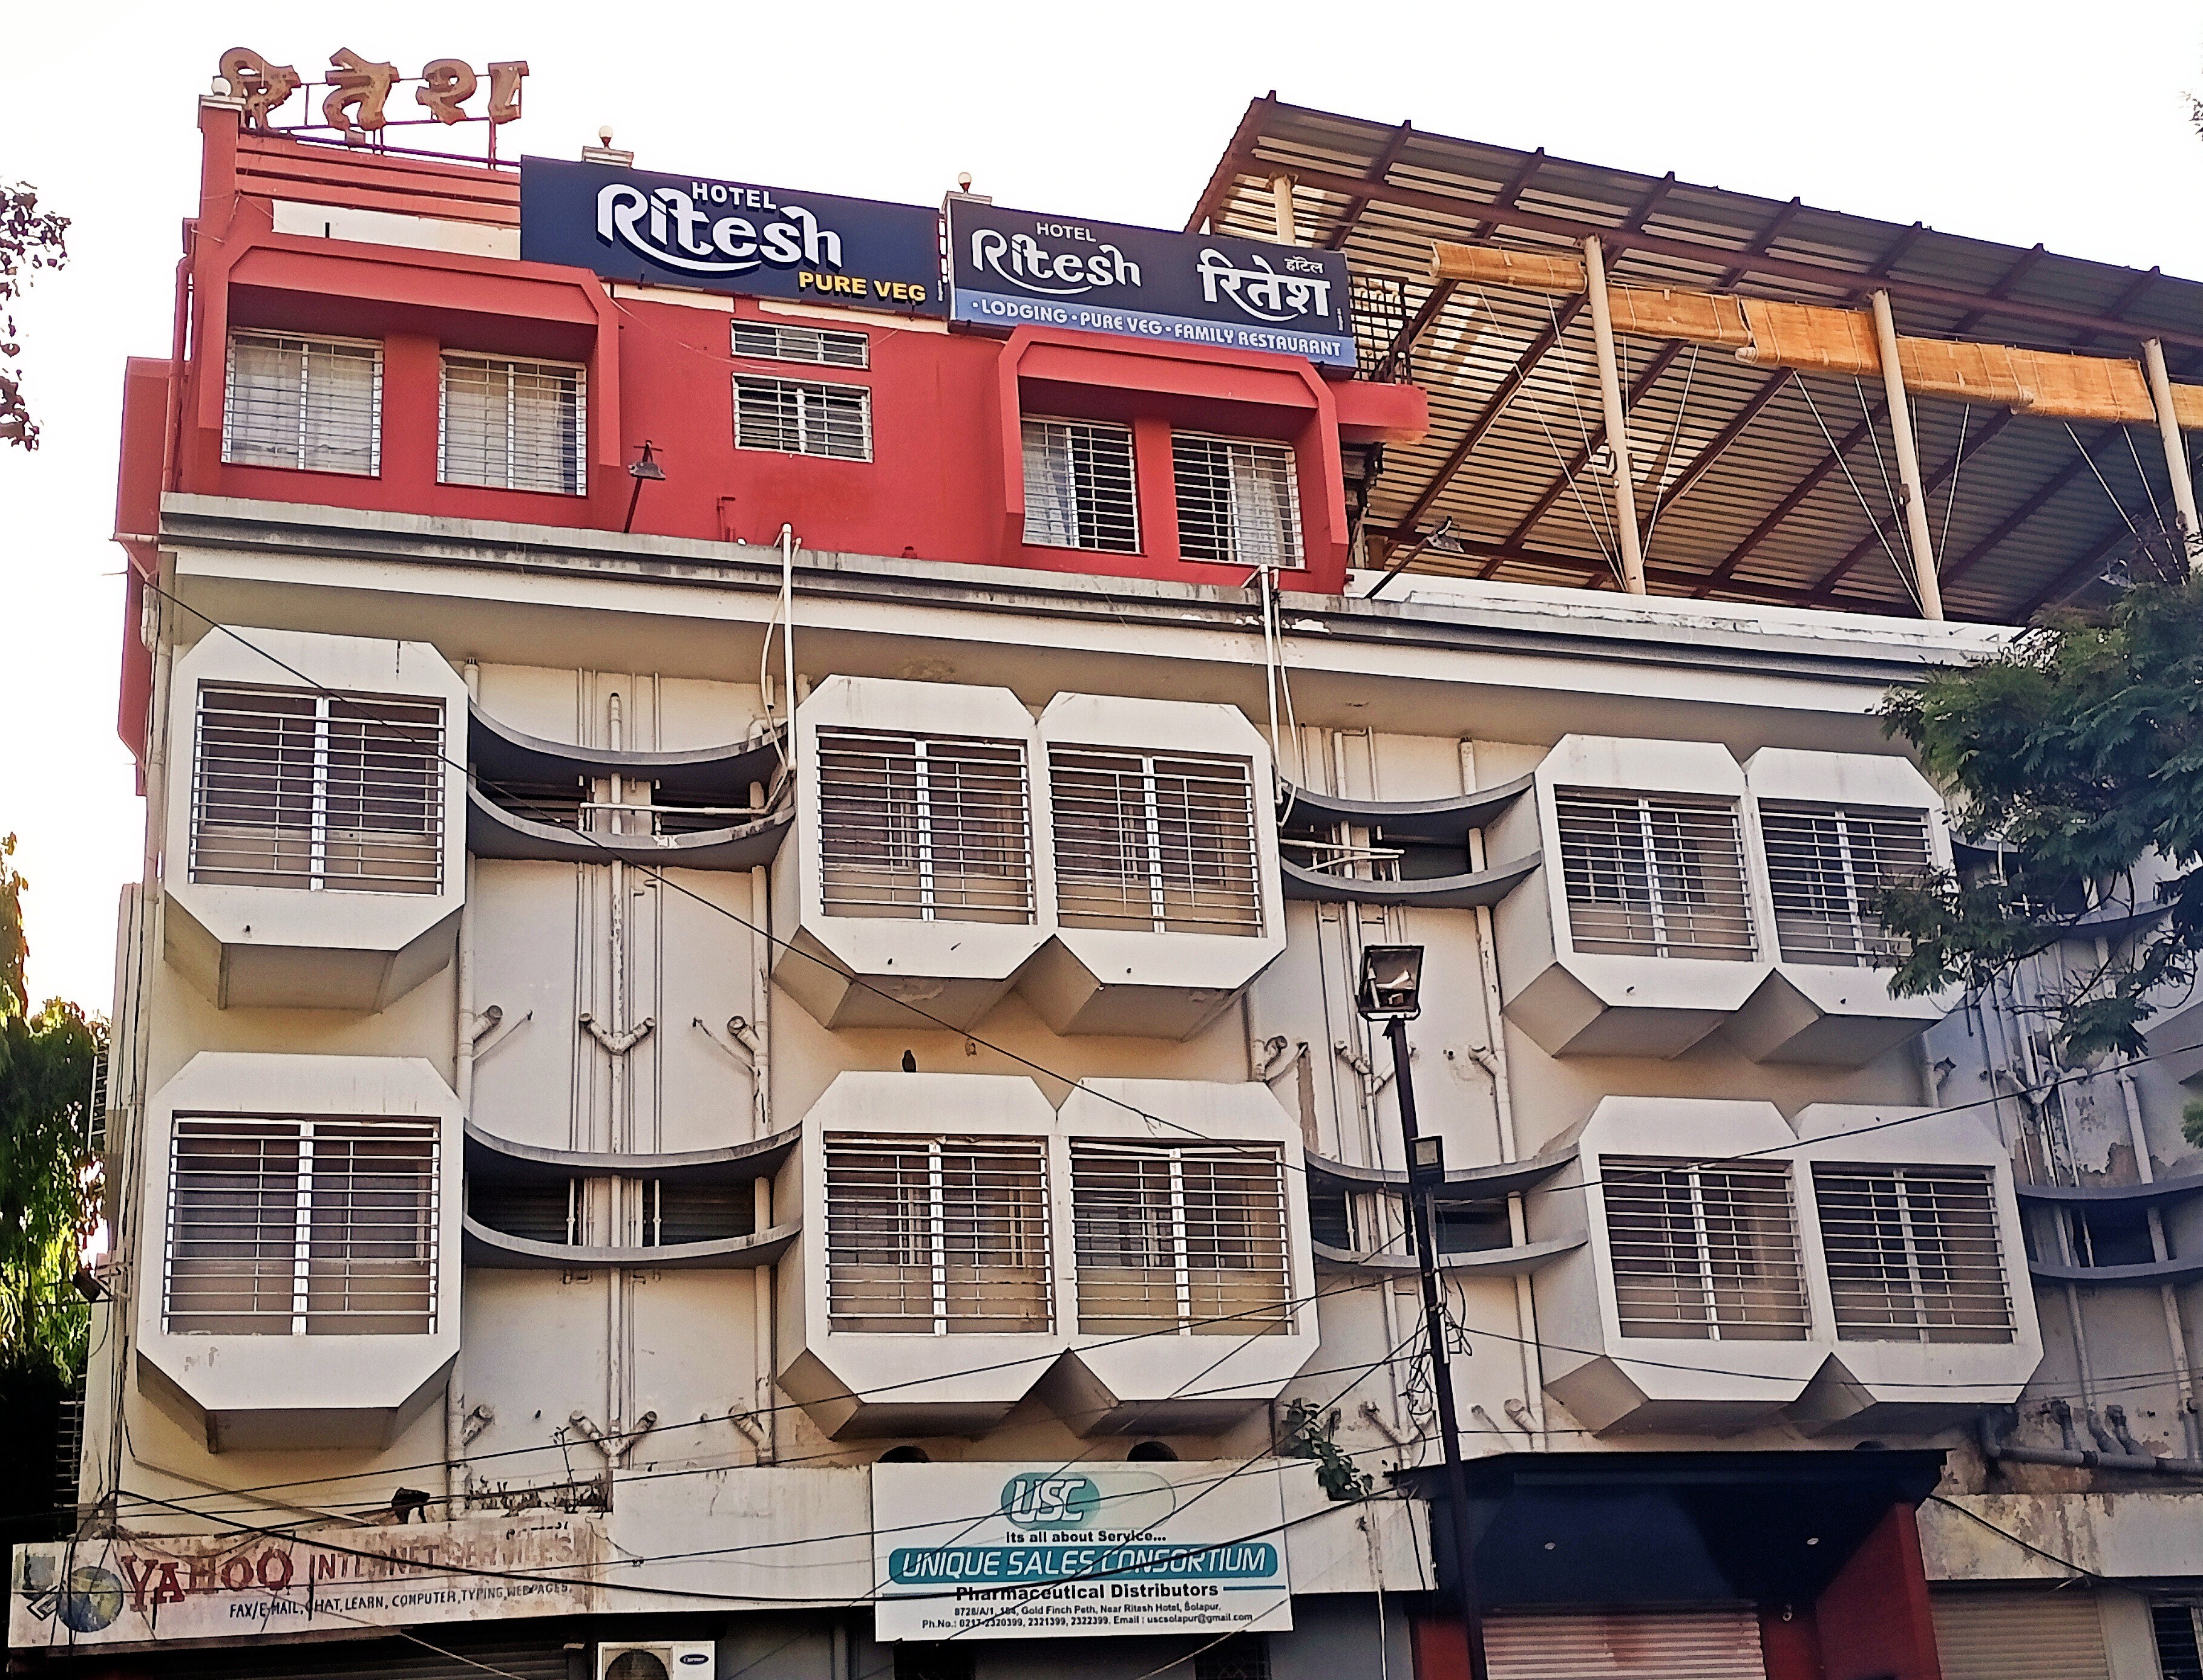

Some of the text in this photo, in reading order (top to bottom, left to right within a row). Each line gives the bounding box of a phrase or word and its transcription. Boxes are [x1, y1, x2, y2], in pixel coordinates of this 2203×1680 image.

[692, 181, 777, 210] HOTEL
[597, 183, 842, 272] Ritesh
[1036, 222, 1096, 242] HOTEL
[971, 229, 1141, 294] Ritesh
[1283, 255, 1323, 274] हॉटेल
[799, 272, 926, 302] PURE VEG
[1197, 248, 1331, 322] रितेश
[981, 299, 1341, 356] LODGING PURE VEG FAMILY RESTAURANT
[1010, 1479, 1087, 1523] USC
[1006, 1531, 1025, 1543] Its
[1030, 1531, 1047, 1543] all
[1052, 1531, 1093, 1543] about
[902, 1546, 1266, 1579] UNIQUE SALES CONSORTIUM
[121, 1546, 293, 1612] YAHOO
[956, 1583, 1219, 1601] Pharmaceutical Distributors
[1021, 1606, 1044, 1615] Gold
[1046, 1605, 1072, 1615] Finch
[1101, 1604, 1121, 1613] Near
[1124, 1604, 1153, 1613] Ritesh
[1114, 1615, 1140, 1625] Email
